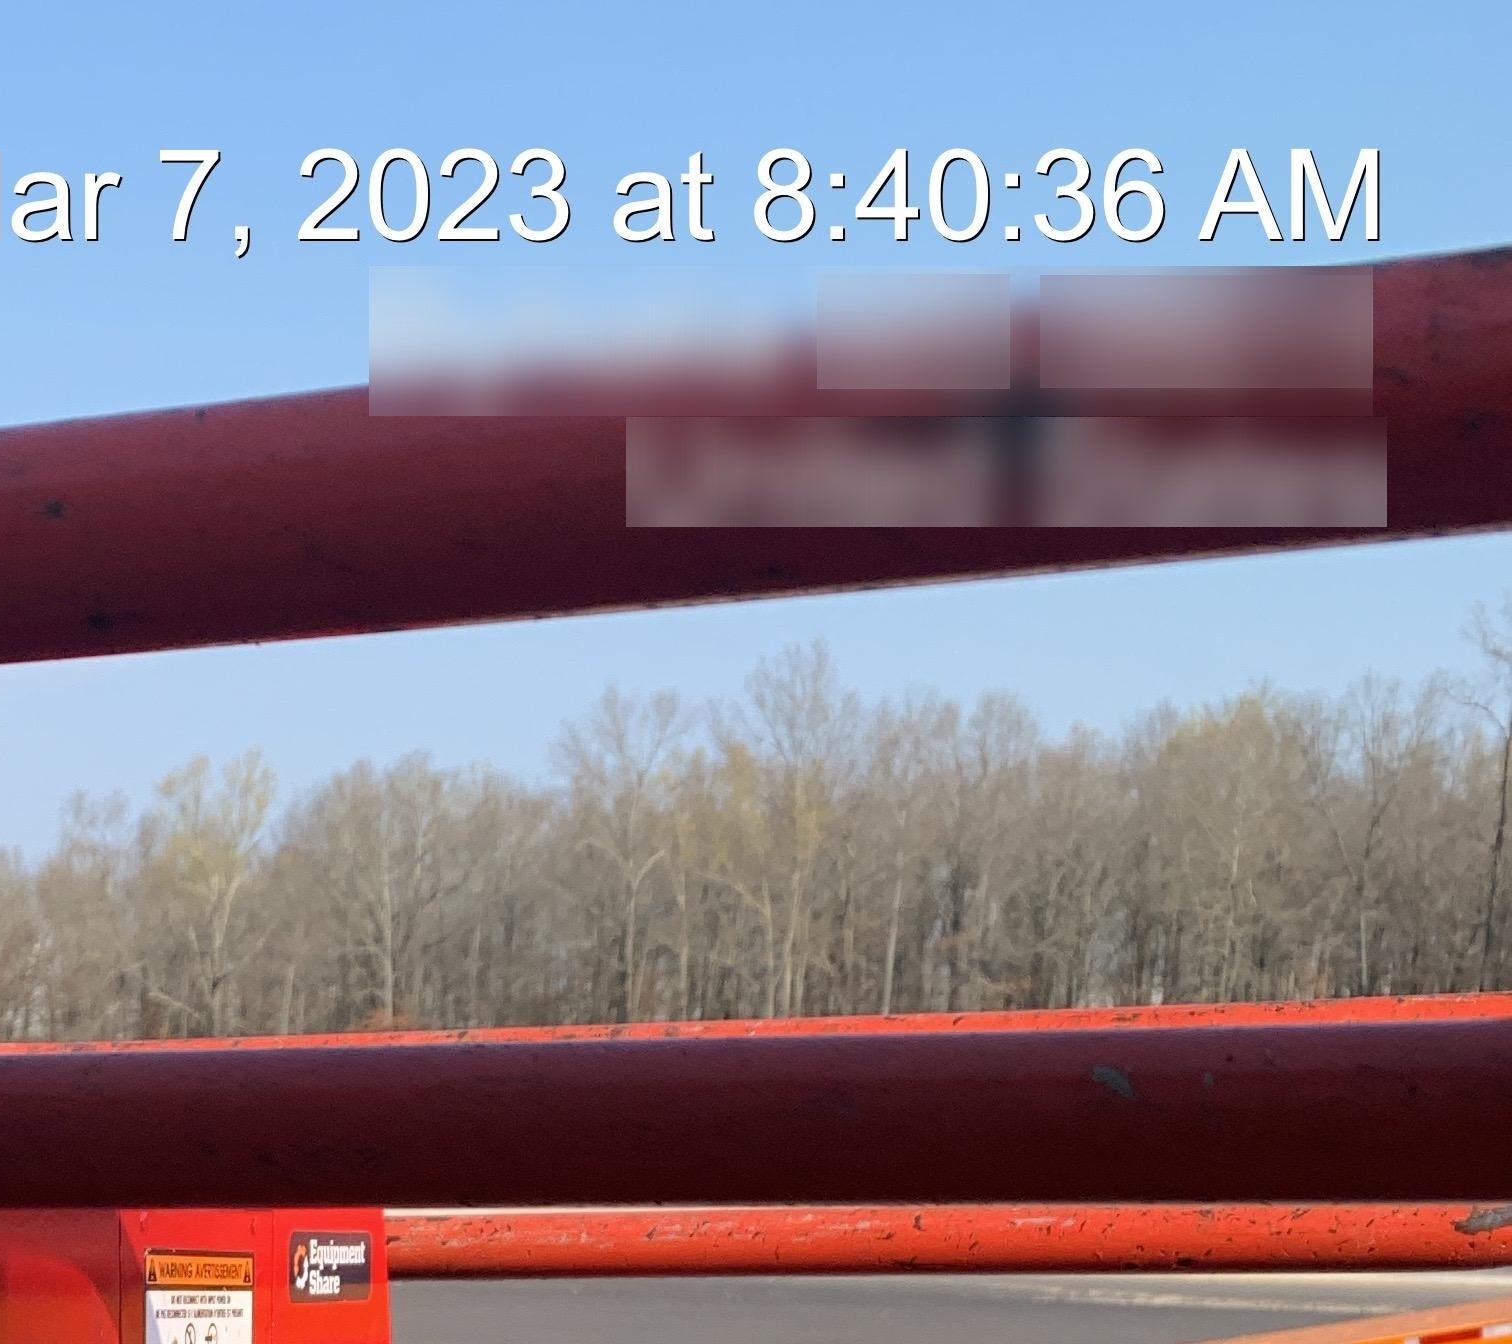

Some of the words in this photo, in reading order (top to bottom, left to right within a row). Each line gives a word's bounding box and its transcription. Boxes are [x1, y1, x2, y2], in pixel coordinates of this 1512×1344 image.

[309, 1239, 366, 1271] Equipment
[158, 1261, 193, 1280] WARNING
[308, 1269, 341, 1295] Share
